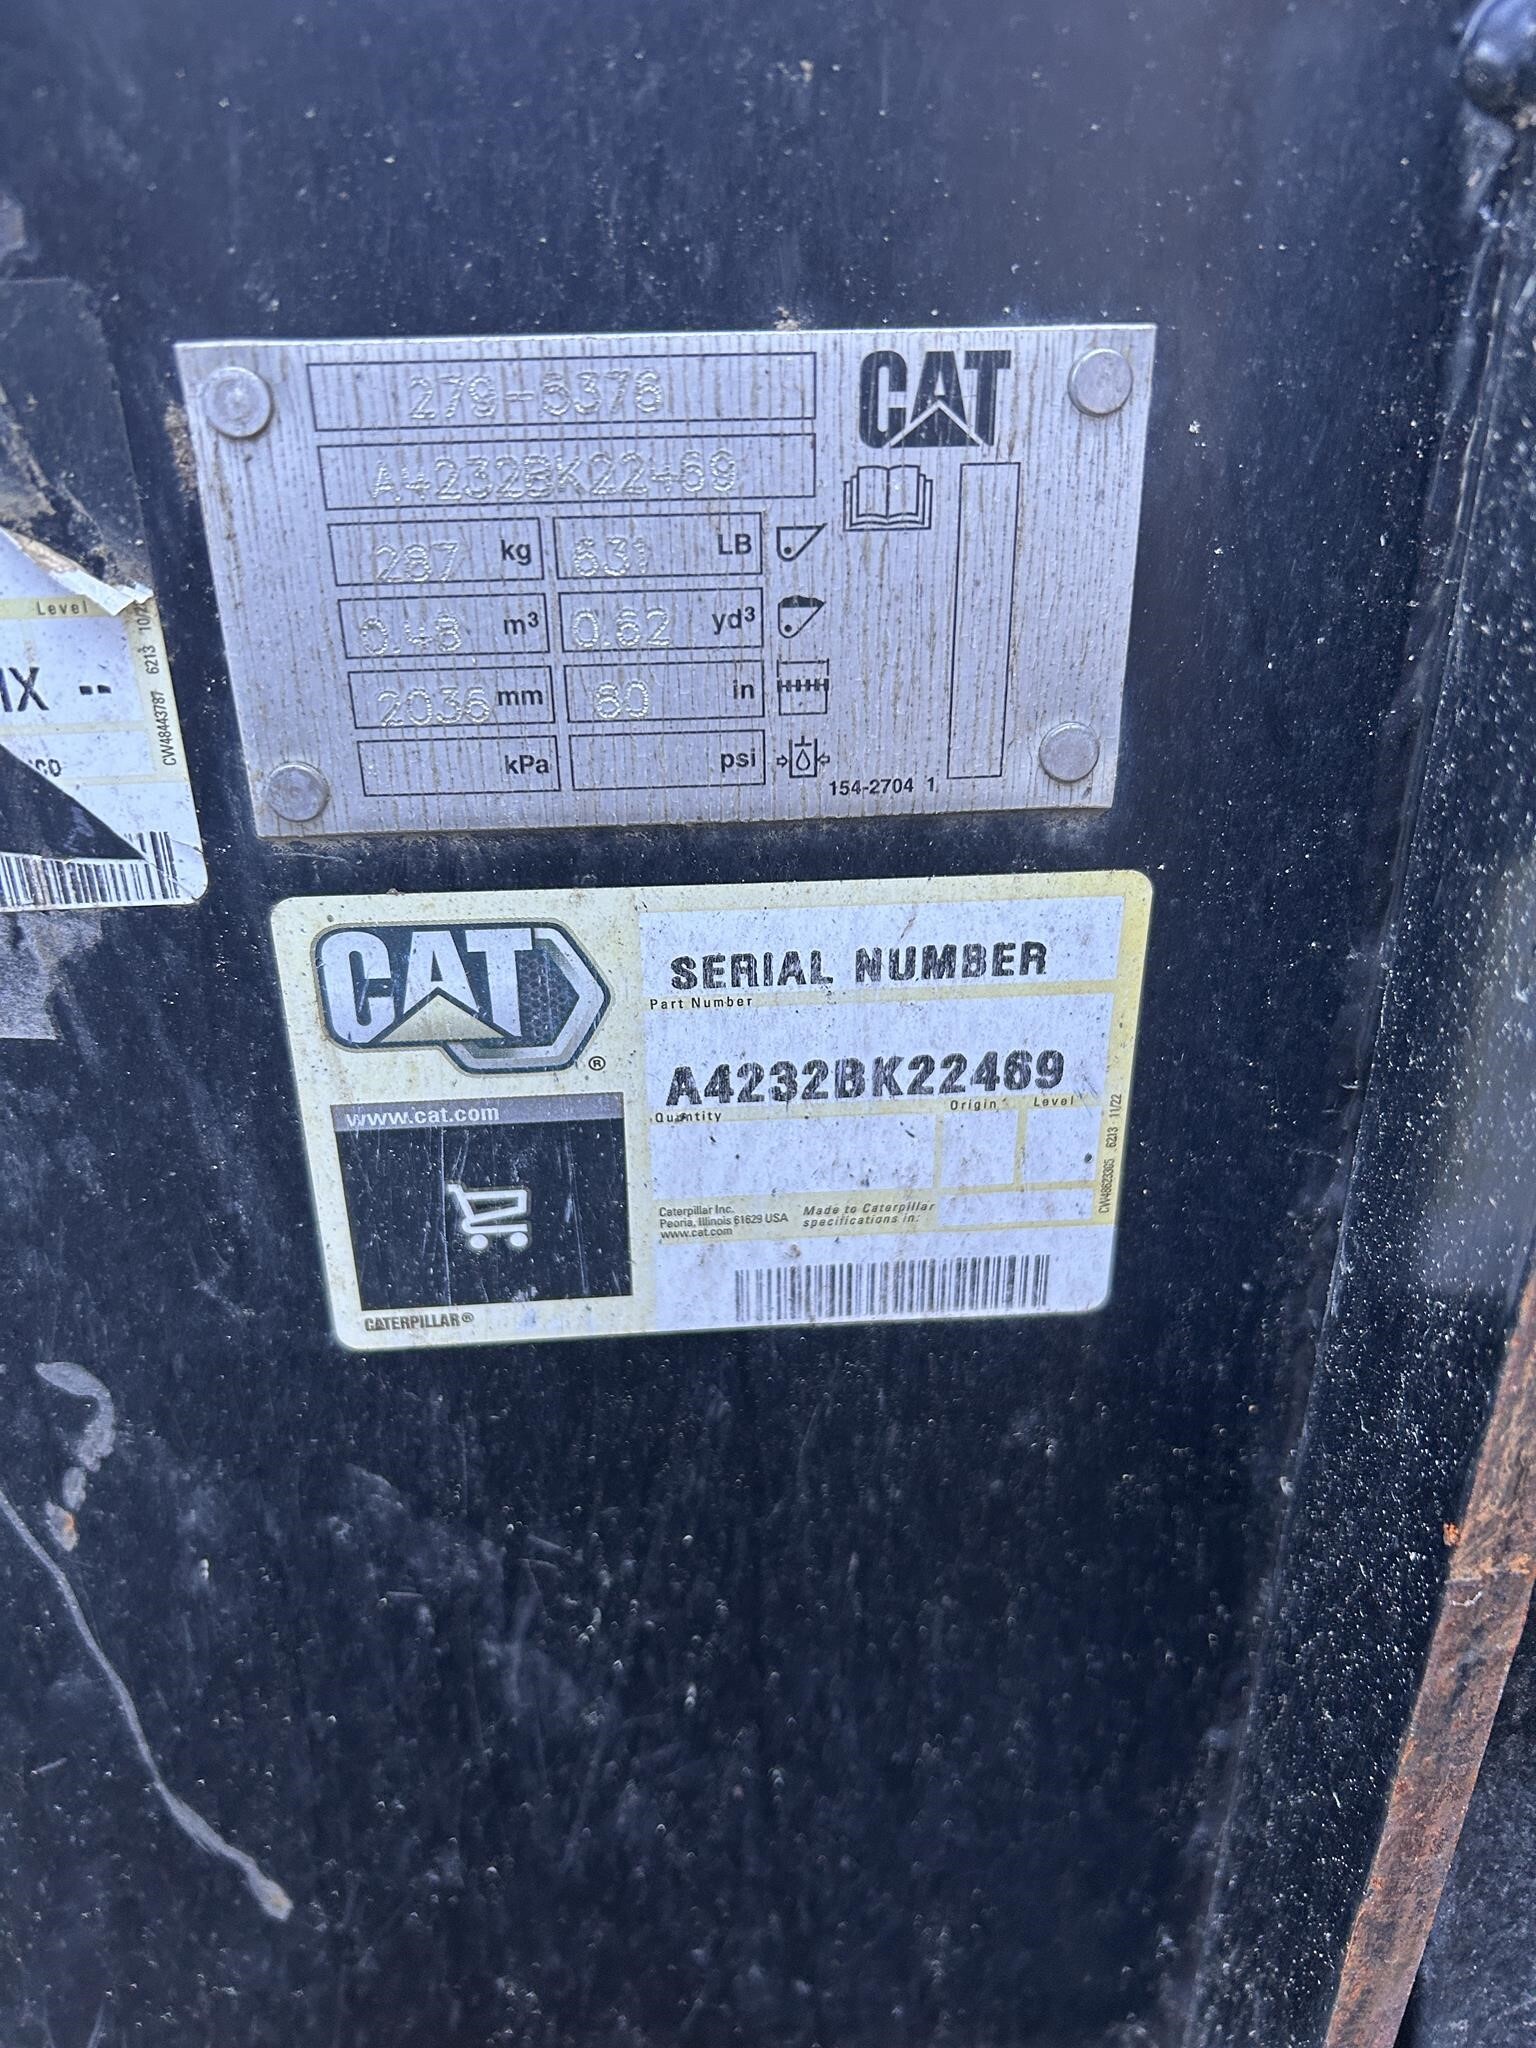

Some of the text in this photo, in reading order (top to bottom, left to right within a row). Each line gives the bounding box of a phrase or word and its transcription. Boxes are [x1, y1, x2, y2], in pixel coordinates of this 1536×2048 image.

[858, 350, 1011, 448] CAT
[718, 533, 752, 555] LB
[375, 539, 531, 583] 287 kg
[37, 600, 88, 616] Level
[360, 608, 463, 654] 0.48
[573, 607, 672, 648] 0.62
[144, 645, 160, 674] 6213
[497, 687, 543, 706] mm
[733, 680, 755, 700] in
[151, 690, 177, 766] CW48443787
[506, 755, 550, 775] kPa
[721, 749, 757, 772] psi
[829, 778, 914, 796] 154-2704
[670, 941, 1048, 990] SERIAL NUMBER
[316, 927, 536, 1044] CAT
[650, 996, 753, 1010] Part Number
[666, 1049, 1065, 1106] A4232BK22469
[950, 1099, 998, 1112] Origin
[1033, 1095, 1075, 1107] Level
[1109, 1094, 1122, 1118] 11/22
[346, 1105, 500, 1127] www.cat.com
[655, 1109, 722, 1123] Quantity
[1105, 1126, 1119, 1148] 6213
[659, 1204, 734, 1217] Caterpillar Inc.
[803, 1201, 937, 1216] Made to Caterpillar
[698, 1216, 732, 1226] Illinois
[733, 1214, 763, 1225] 61629
[764, 1213, 789, 1224] USA
[803, 1213, 898, 1228] specifications
[660, 1227, 733, 1239] www.cat.com
